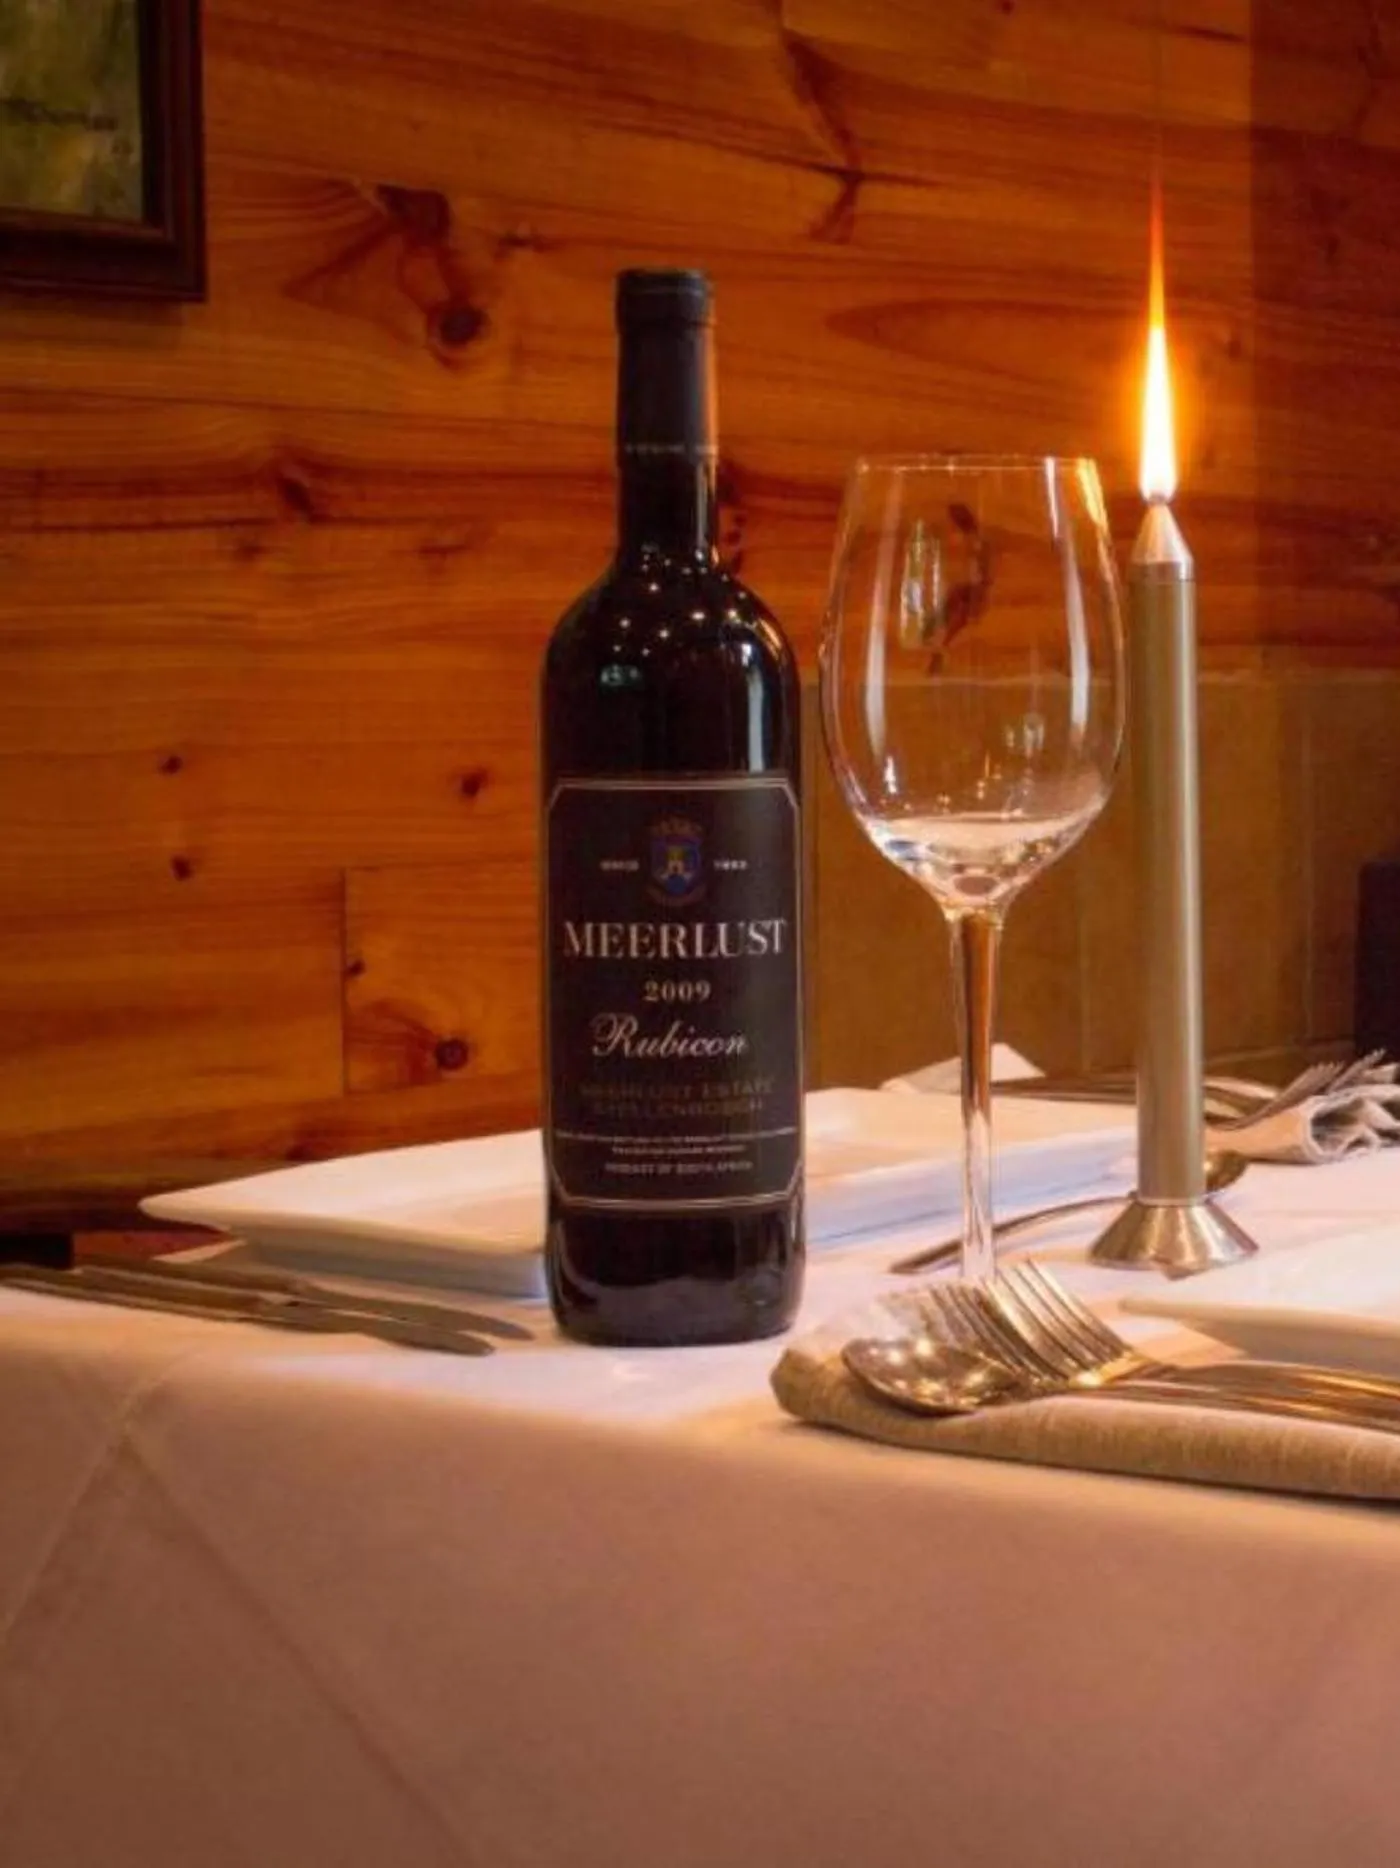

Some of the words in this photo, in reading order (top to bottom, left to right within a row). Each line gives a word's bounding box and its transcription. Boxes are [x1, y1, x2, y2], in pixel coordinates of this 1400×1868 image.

[564, 918, 787, 958] MEERLUST
[644, 979, 711, 1001] 2009
[589, 1012, 748, 1058] Rubicon
